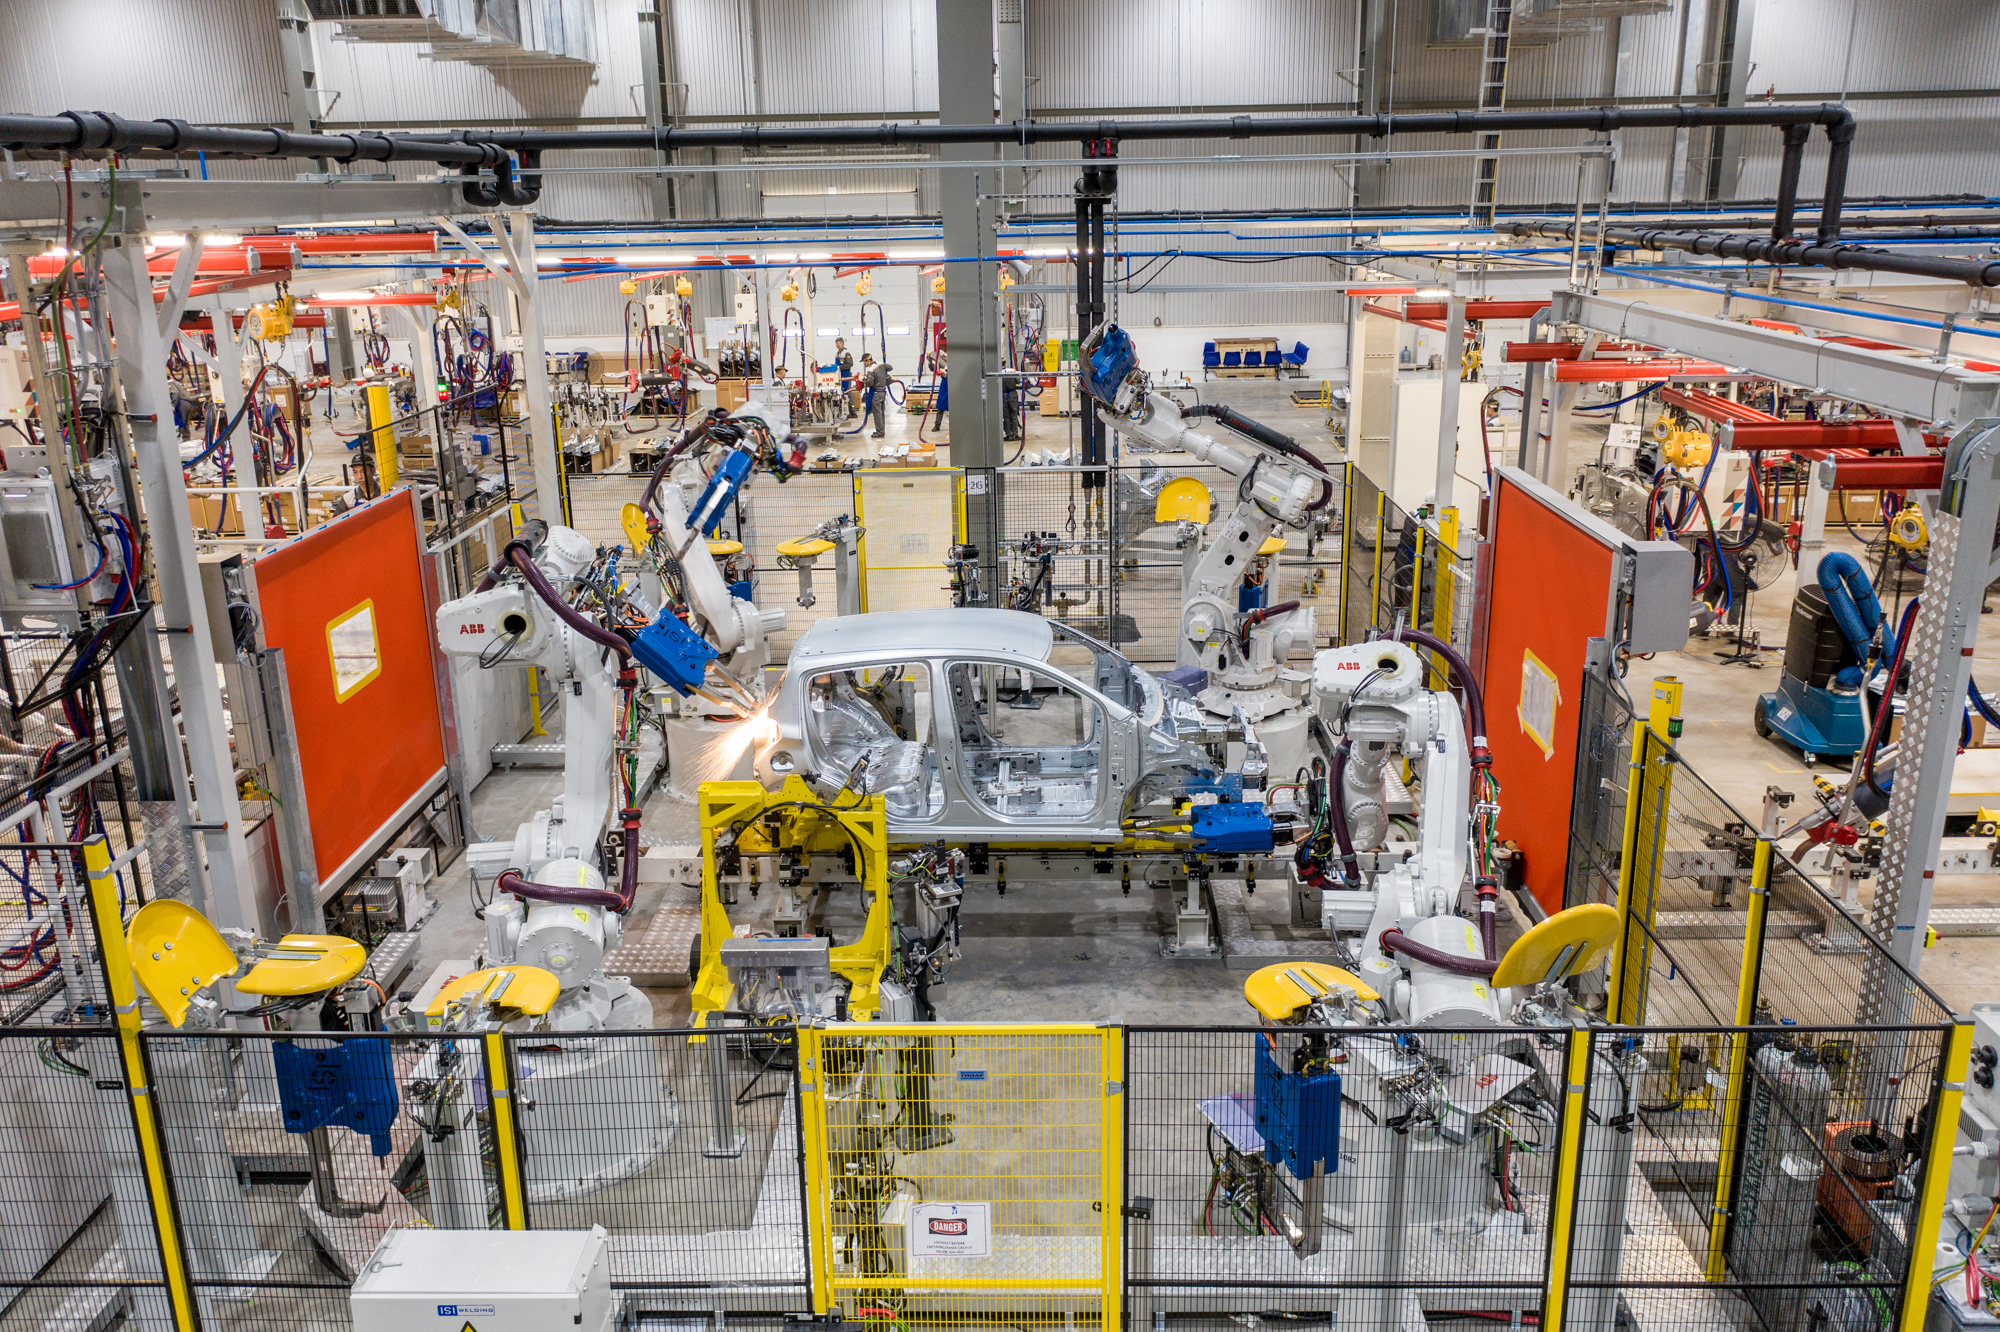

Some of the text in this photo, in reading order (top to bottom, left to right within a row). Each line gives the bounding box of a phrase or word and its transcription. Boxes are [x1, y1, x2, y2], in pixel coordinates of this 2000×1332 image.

[970, 480, 983, 490] 2G
[459, 623, 485, 635] ABB
[663, 629, 687, 645] ISI
[1337, 662, 1361, 671] ABB
[1227, 809, 1251, 818] ISI
[306, 1064, 341, 1091] ISI
[1475, 1073, 1499, 1090] ABB
[1339, 1152, 1357, 1164] 1082
[933, 1221, 963, 1232] DANGER
[440, 1306, 456, 1315] ISI
